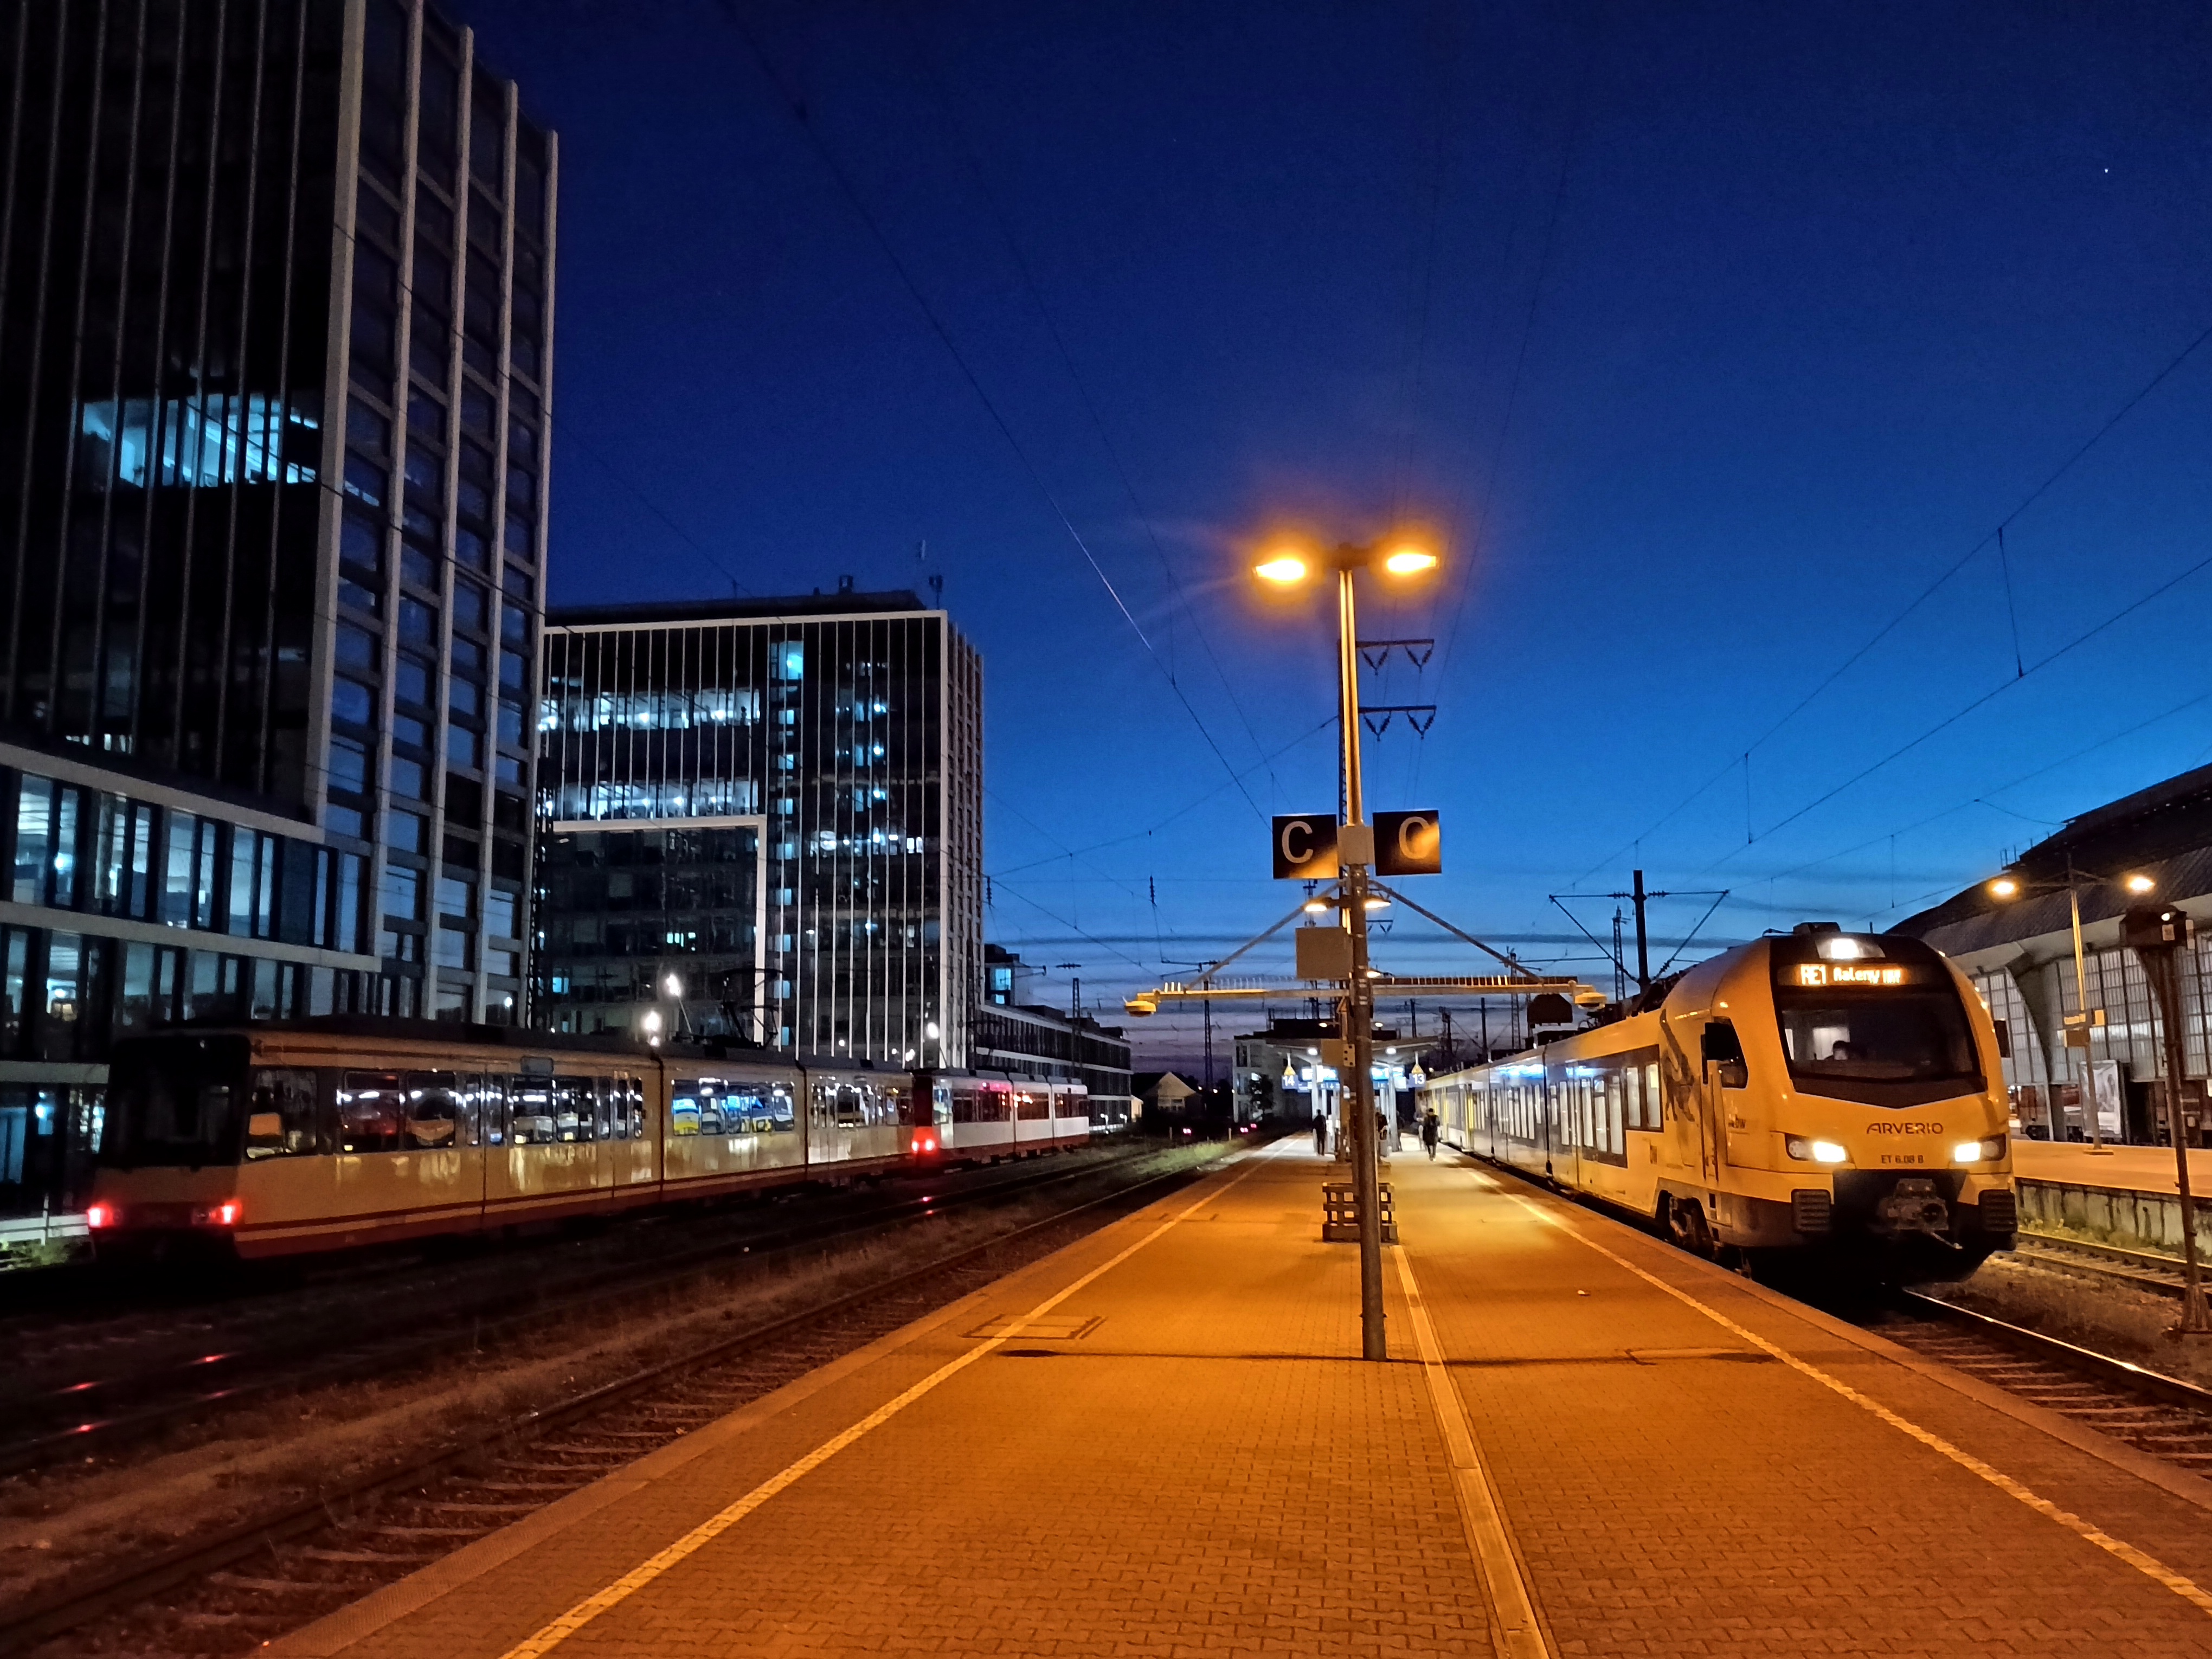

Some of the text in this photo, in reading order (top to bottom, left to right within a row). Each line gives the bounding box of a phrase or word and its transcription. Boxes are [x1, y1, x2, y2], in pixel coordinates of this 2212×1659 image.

[1282, 821, 1313, 863] C
[1399, 816, 1430, 860] C
[1801, 964, 1827, 985] RE1
[1283, 1075, 1295, 1086] 14
[1412, 1073, 1425, 1084] 13
[1866, 1122, 1944, 1134] ARVERIO
[1881, 1154, 1892, 1164] ET
